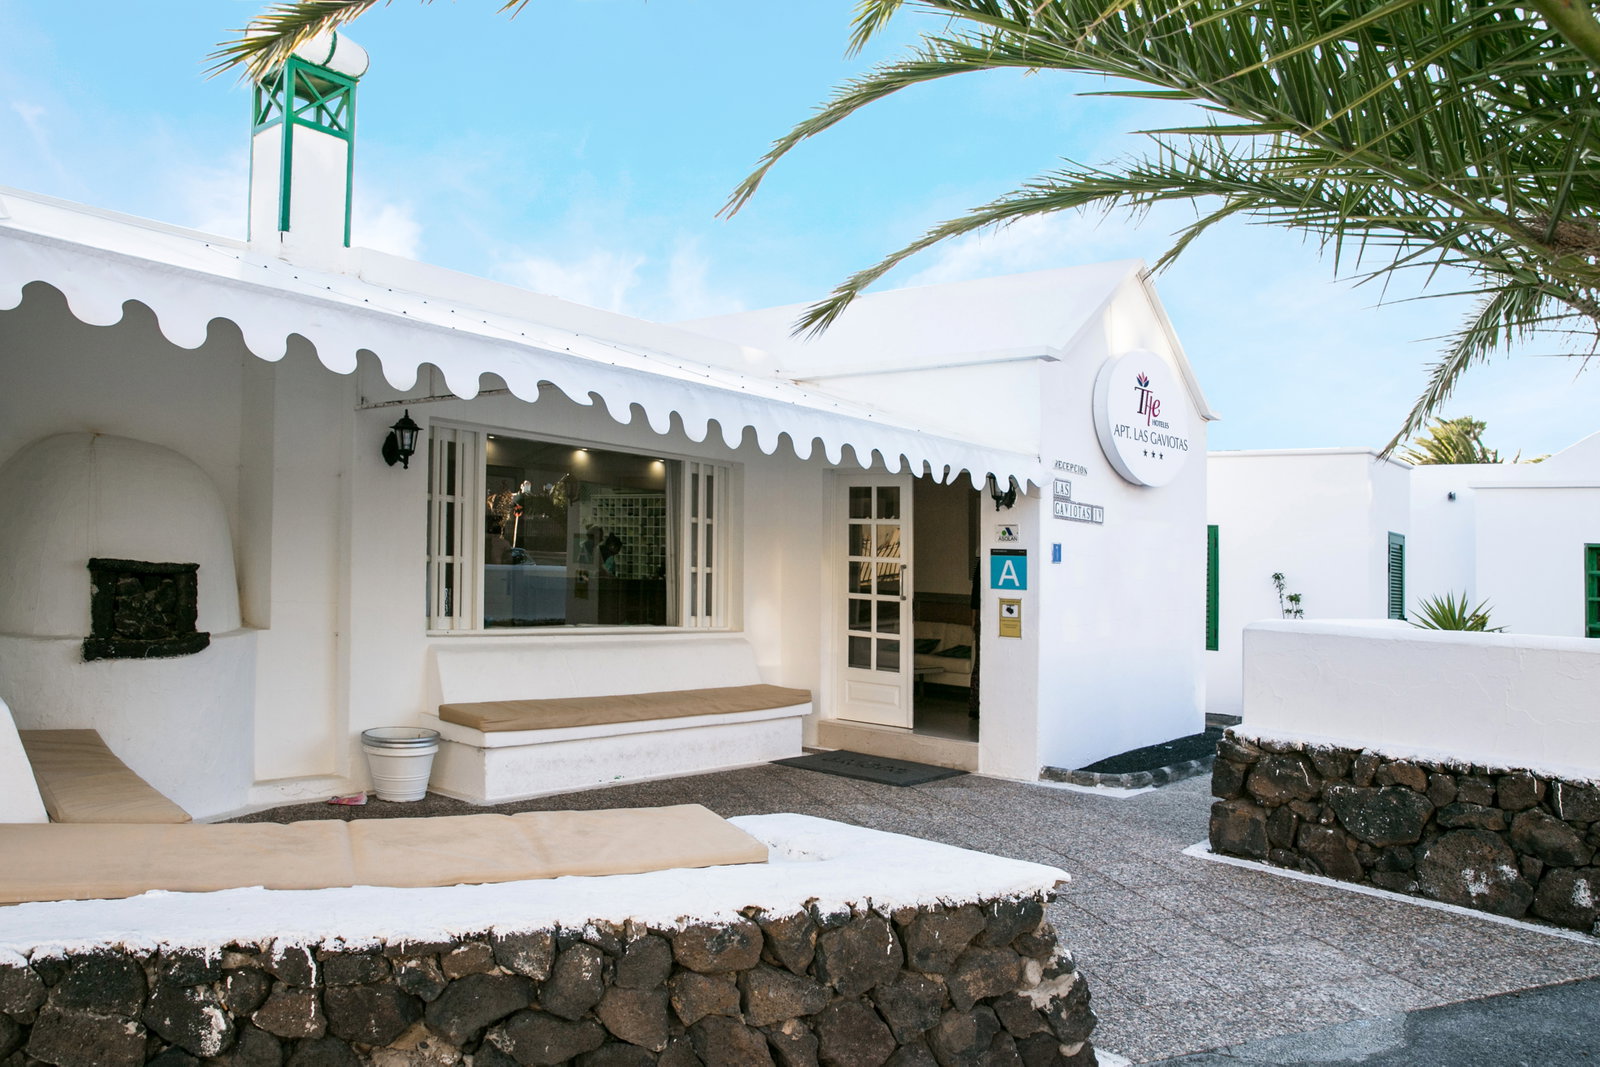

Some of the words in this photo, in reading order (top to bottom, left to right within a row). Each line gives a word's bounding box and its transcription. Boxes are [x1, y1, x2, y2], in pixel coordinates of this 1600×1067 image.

[1151, 419, 1170, 430] HOTELES
[1113, 424, 1132, 440] APT.
[1133, 427, 1149, 443] LAS
[1150, 431, 1189, 452] GAVIOTAS
[1055, 481, 1069, 496] LAS
[1055, 502, 1092, 520] GAVIOTAS
[998, 559, 1020, 587] A
